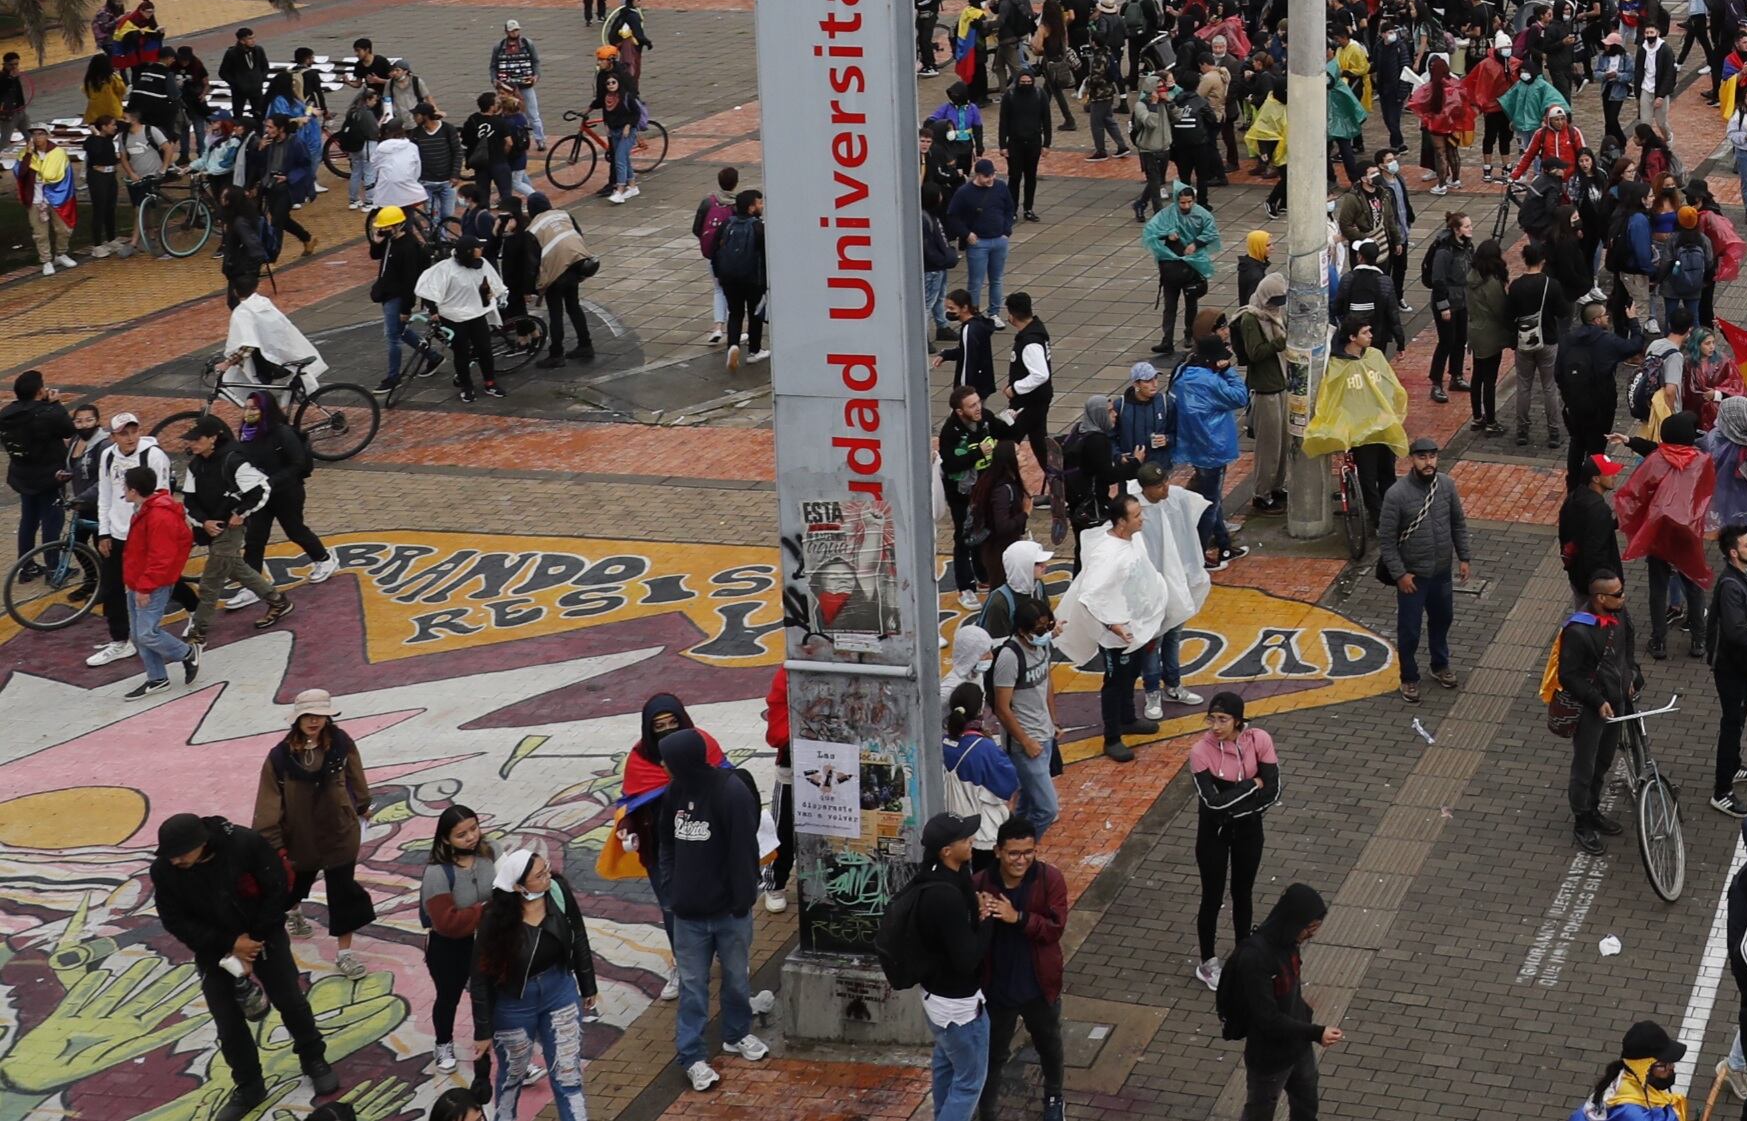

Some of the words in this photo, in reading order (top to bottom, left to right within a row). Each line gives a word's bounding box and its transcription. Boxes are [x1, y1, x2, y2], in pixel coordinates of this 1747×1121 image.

[803, 501, 844, 523] ESTA
[816, 750, 836, 760] Las
[797, 810, 813, 818] van
[827, 814, 859, 823] volver
